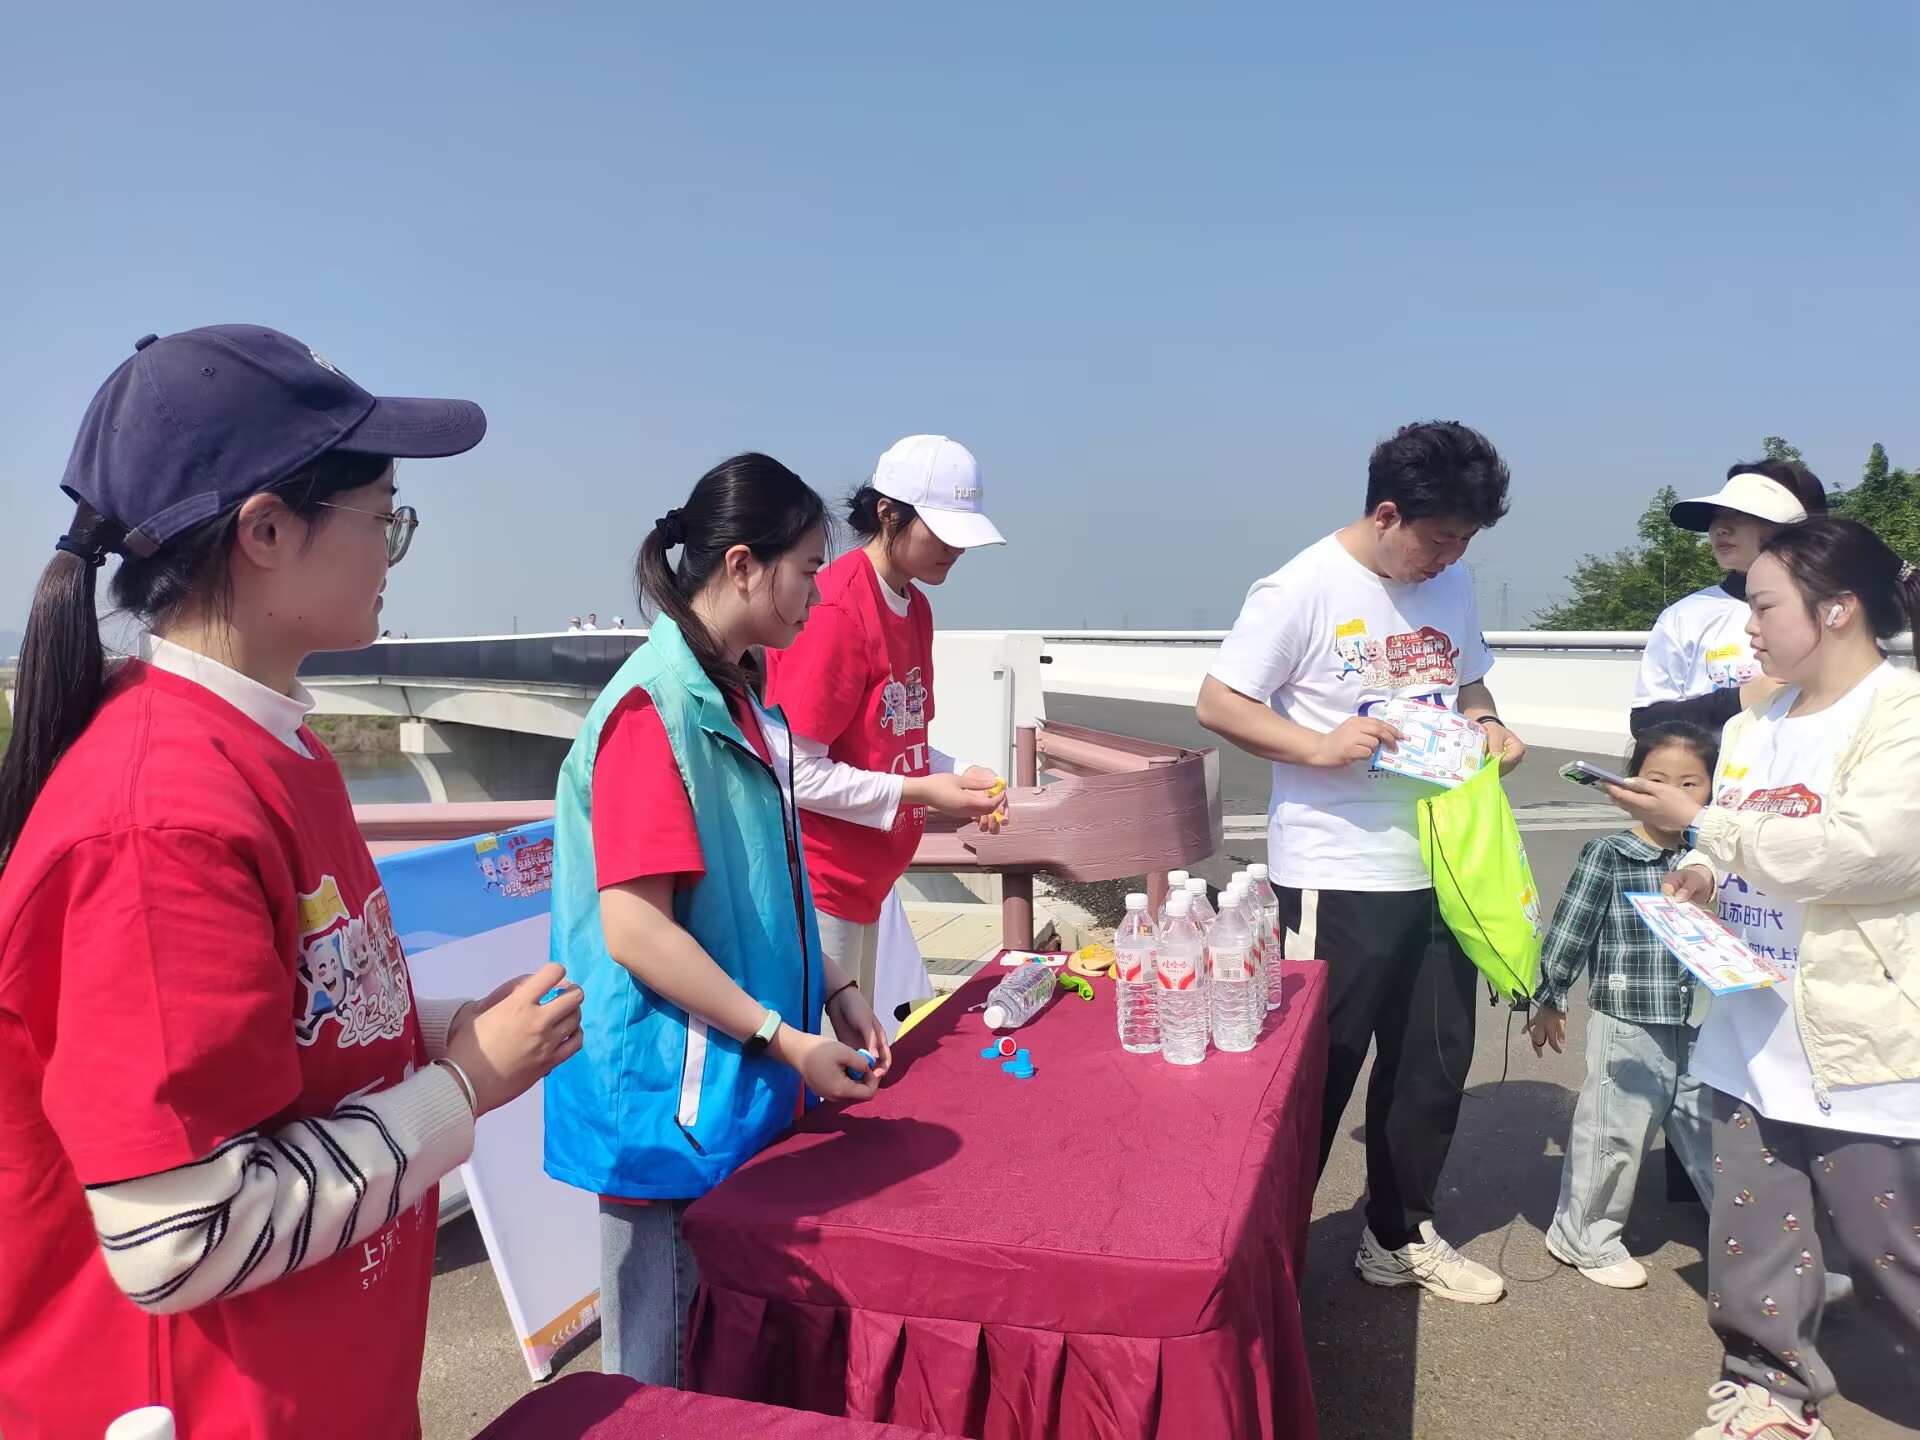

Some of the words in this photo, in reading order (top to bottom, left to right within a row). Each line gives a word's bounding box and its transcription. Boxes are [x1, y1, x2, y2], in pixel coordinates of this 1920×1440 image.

[1717, 899, 1783, 930] 江苏时代
[341, 985, 389, 1043] 2026
